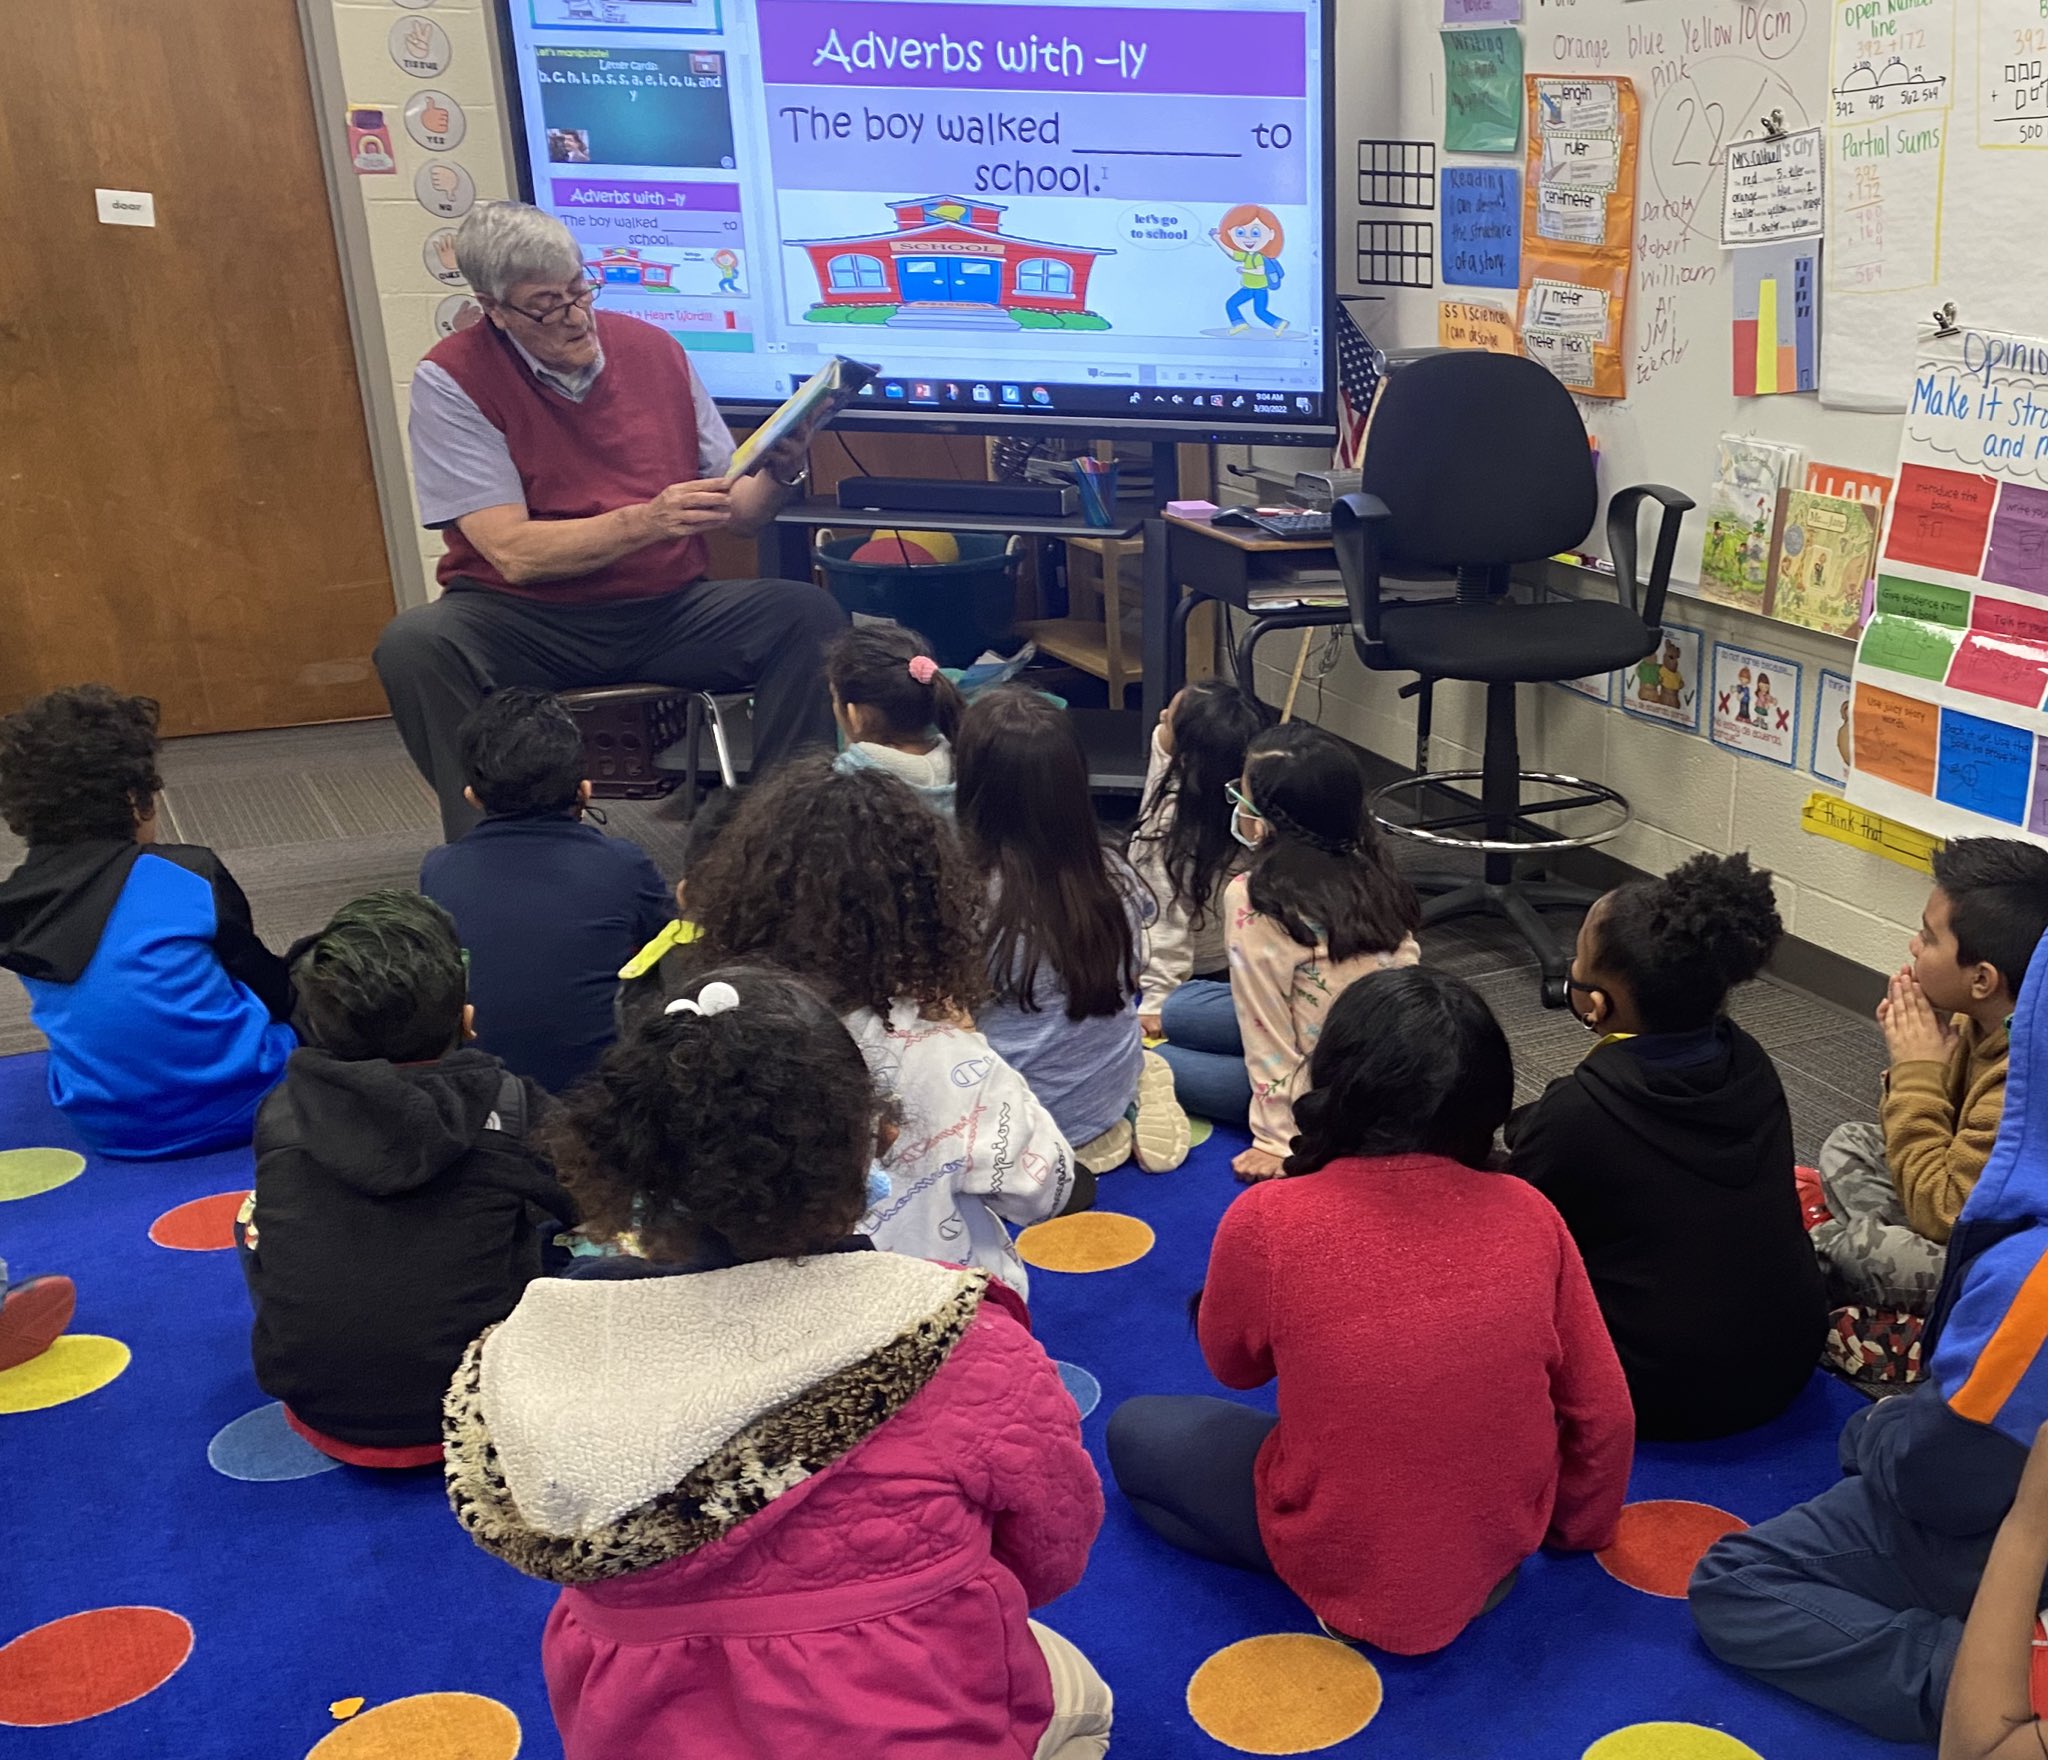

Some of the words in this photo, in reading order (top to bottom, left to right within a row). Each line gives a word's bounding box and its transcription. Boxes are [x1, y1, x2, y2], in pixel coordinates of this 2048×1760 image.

[1845, 1, 1880, 30] Open
[1871, 19, 1897, 38] line
[1553, 34, 1610, 68] Orange
[1627, 24, 1664, 58] blue
[1681, 16, 1732, 54] Yellow
[1762, 9, 1791, 41] cm
[2014, 28, 2047, 55] 392
[812, 29, 983, 74] Adverbs
[997, 36, 1084, 77] with
[1451, 33, 1504, 64] Writing
[699, 75, 721, 88] and
[1651, 55, 1691, 98] pink
[629, 89, 638, 102] y
[1836, 101, 1855, 116] 392
[780, 106, 851, 143] The
[864, 107, 924, 145] boy
[937, 111, 1060, 146] walked
[1251, 122, 1292, 150] to
[426, 136, 445, 144] YES
[1564, 138, 1590, 156] ruler
[1793, 137, 1814, 157] City
[1842, 125, 1889, 161] Partial
[1897, 128, 1940, 154] Sums
[975, 161, 1101, 195] school.
[1451, 169, 1504, 198] Reading
[1743, 171, 1757, 185] red
[570, 188, 630, 205] Adverbs
[633, 190, 665, 205] with
[1545, 188, 1594, 209] centimeter
[439, 203, 452, 211] NO
[560, 214, 586, 226] The
[589, 214, 611, 228] boy
[614, 216, 658, 228] walked
[723, 220, 737, 230] to
[1134, 213, 1159, 224] let's
[1161, 216, 1178, 227] go
[1131, 229, 1143, 239] to
[1146, 228, 1188, 240] school
[900, 243, 996, 253] SCHOOL
[1552, 289, 1583, 306] meter
[1451, 325, 1465, 340] can
[1528, 332, 1555, 350] meter
[1911, 374, 1969, 420] Make
[1983, 433, 2026, 459] and
[1824, 802, 1855, 832] think
[1861, 815, 1882, 842] that
